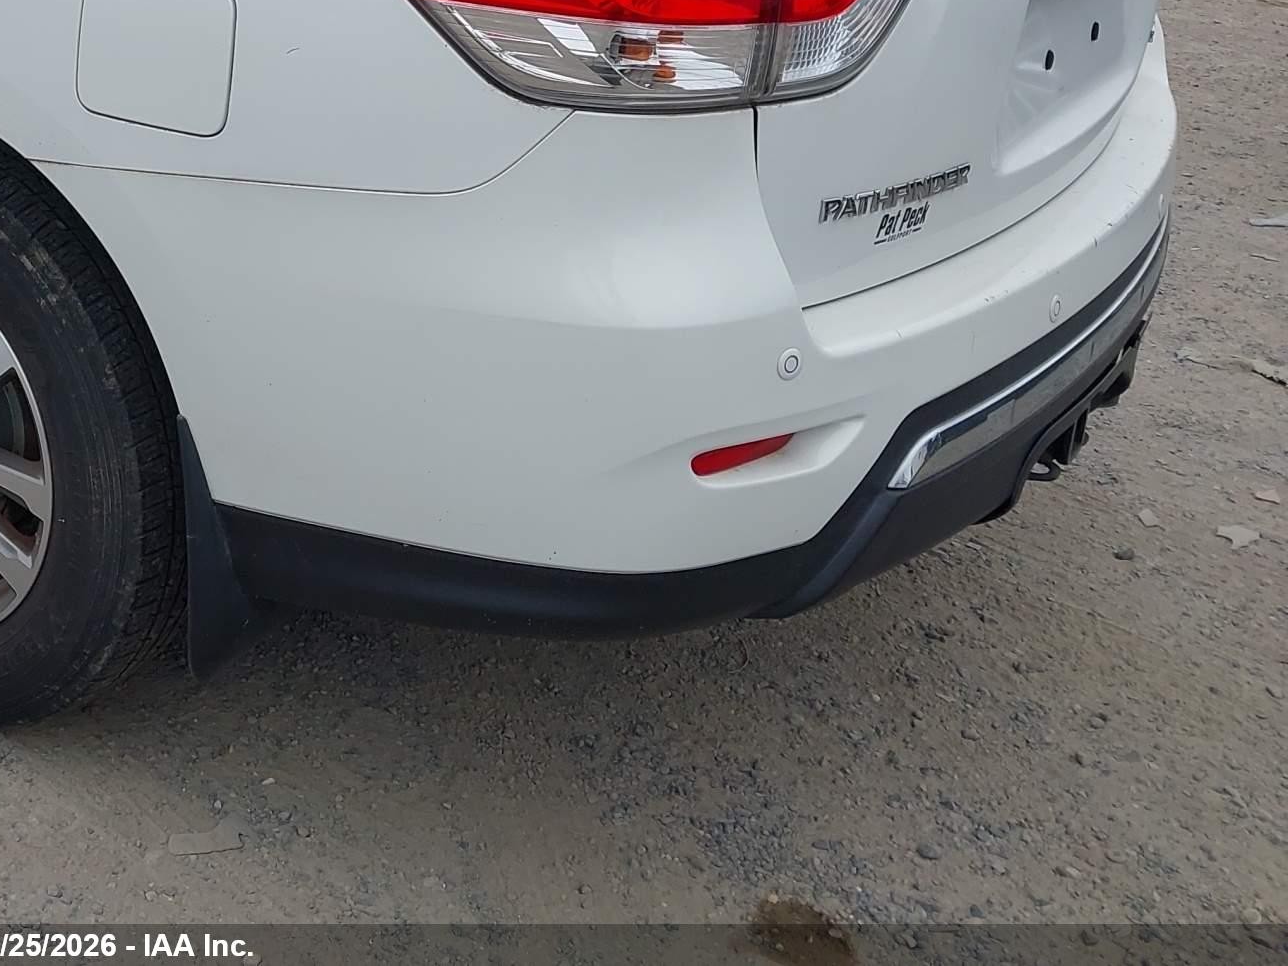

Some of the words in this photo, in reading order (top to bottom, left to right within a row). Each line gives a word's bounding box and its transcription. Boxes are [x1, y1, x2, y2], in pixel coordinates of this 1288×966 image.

[818, 162, 971, 224] PATHFINDER
[876, 210, 902, 238] Pat
[899, 201, 930, 232] Peck
